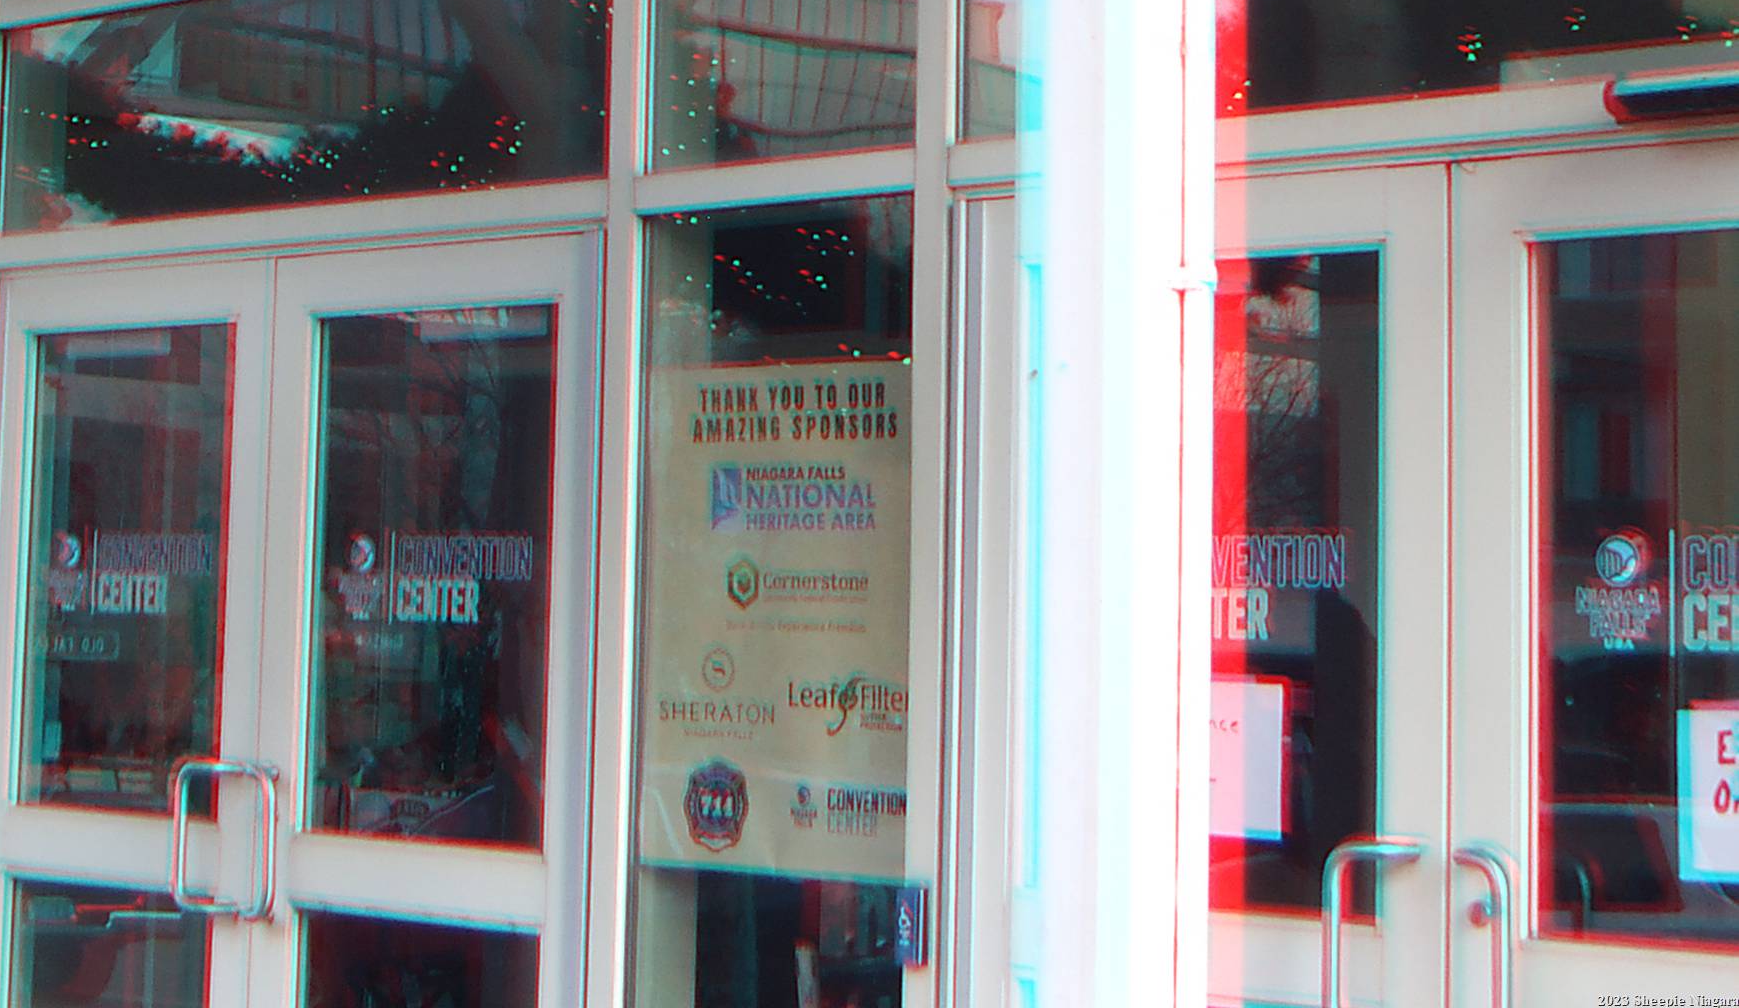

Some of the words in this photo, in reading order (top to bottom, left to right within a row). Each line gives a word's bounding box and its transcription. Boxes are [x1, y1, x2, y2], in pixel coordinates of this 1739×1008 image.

[699, 385, 759, 414] THANK
[768, 383, 805, 411] YOU
[814, 382, 838, 410] TO
[847, 381, 886, 410] OUR
[692, 415, 781, 444] AMAZING
[792, 411, 899, 441] SPONSORS
[746, 466, 805, 482] NIAGARA
[808, 465, 846, 481] FALLS
[746, 483, 877, 510] NATIONAL
[746, 512, 826, 532] HERITAGE
[831, 512, 877, 532] AREA
[396, 531, 534, 581] CONVENTION
[96, 570, 168, 614] CENTER
[763, 571, 869, 592] Cornerstone
[394, 575, 480, 624] CENTER
[659, 700, 775, 726] SHERATON
[827, 787, 907, 817] CONVENTION
